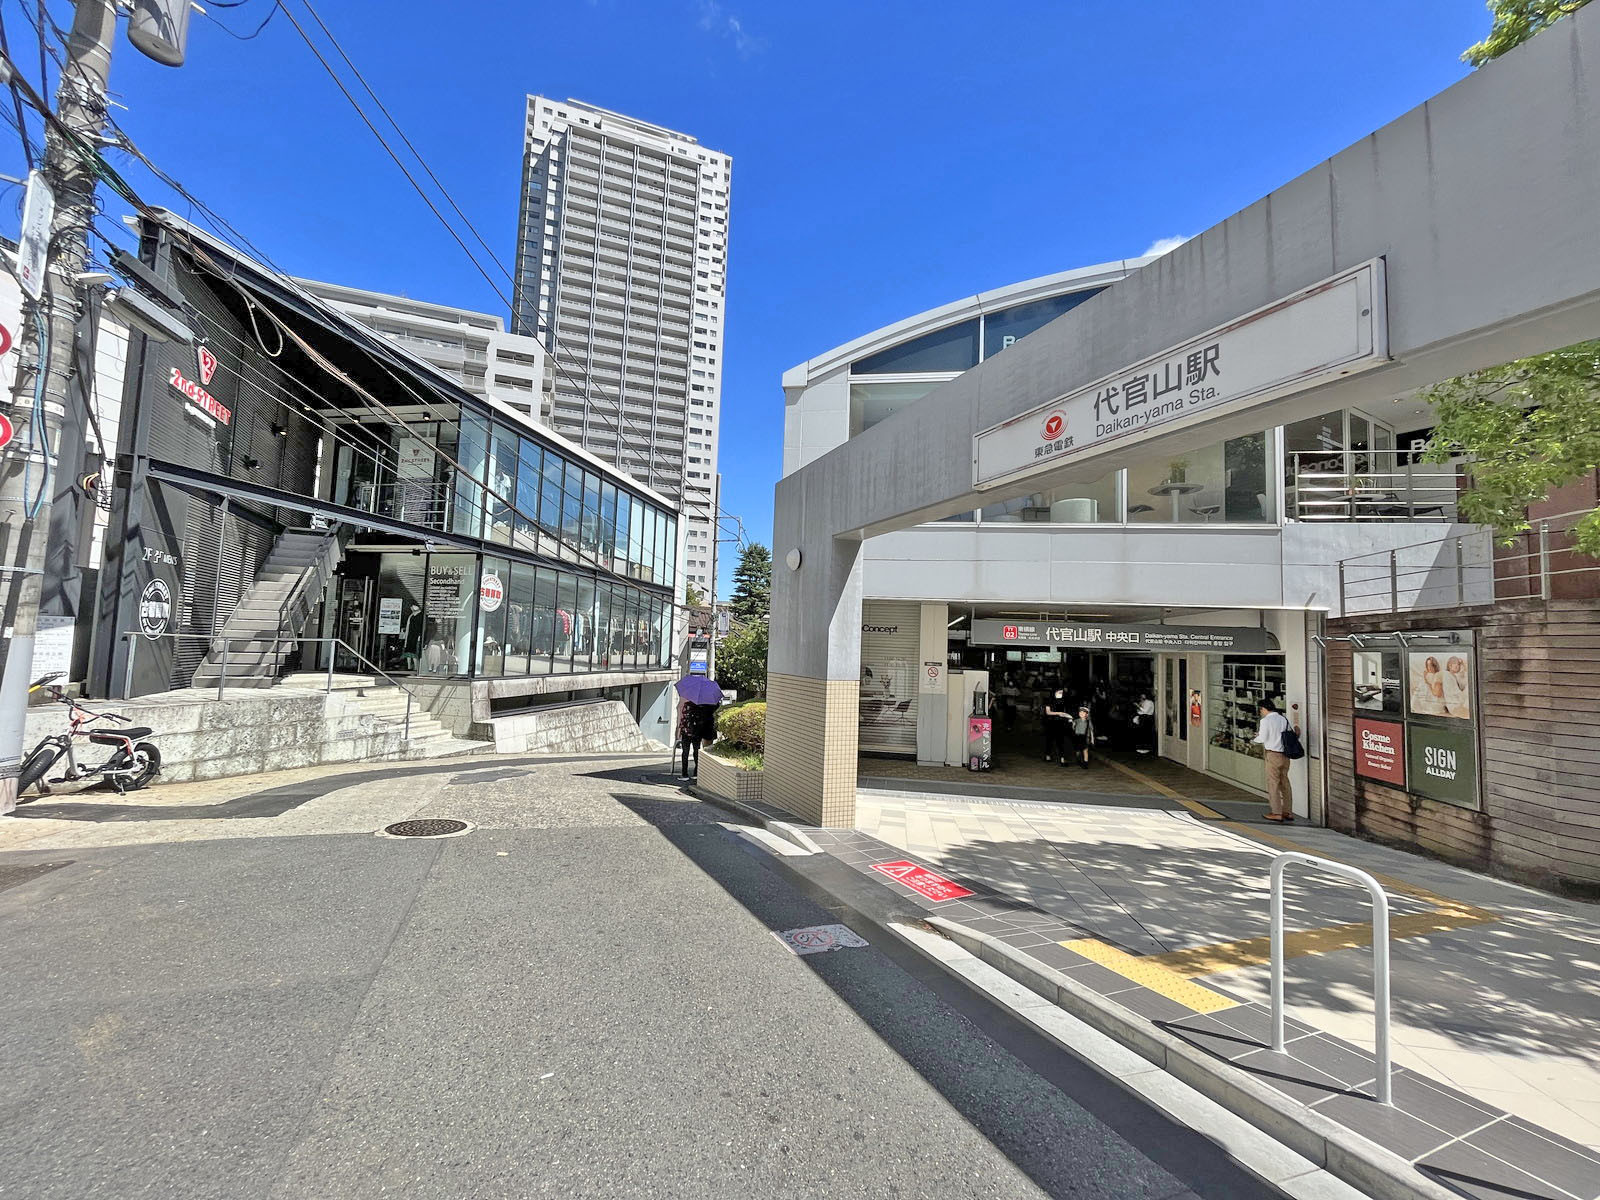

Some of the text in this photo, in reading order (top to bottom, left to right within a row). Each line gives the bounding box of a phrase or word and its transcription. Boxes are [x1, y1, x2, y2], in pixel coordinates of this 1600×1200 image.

[1093, 343, 1221, 421] 代官山駅
[195, 386, 231, 425] STREET
[1096, 398, 1184, 438] Daikan-yama
[1189, 386, 1220, 405] Sta.
[1034, 436, 1074, 459] 東急電鉄
[431, 565, 448, 575] BUY
[454, 566, 473, 576] SELL
[430, 577, 465, 585] Secondhand
[862, 624, 898, 636] Concept
[1046, 627, 1102, 642] 代官山駅
[1105, 632, 1140, 643] 中央口
[1362, 730, 1390, 743] Cosme
[1362, 740, 1395, 755] Kitchen
[1425, 746, 1456, 770] SIGN
[1426, 766, 1456, 780] ALLDAY
